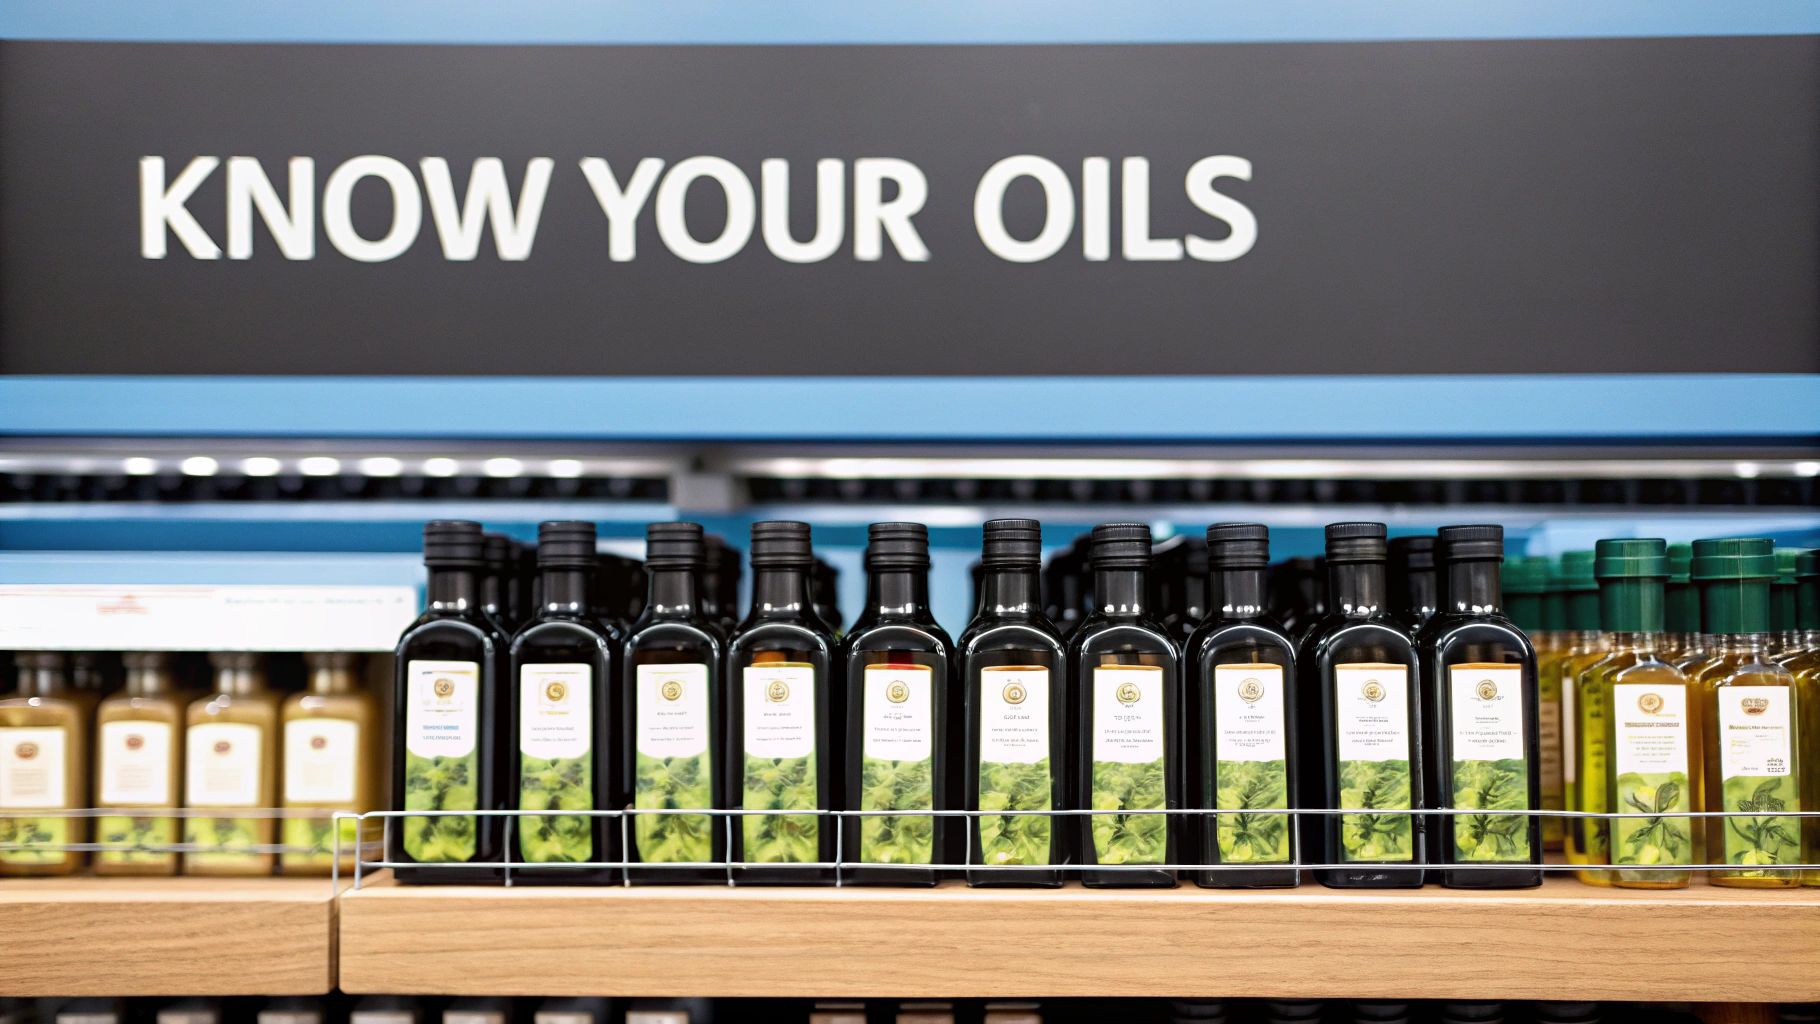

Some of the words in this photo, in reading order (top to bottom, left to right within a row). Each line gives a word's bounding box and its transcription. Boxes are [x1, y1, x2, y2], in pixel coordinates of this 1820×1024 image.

[139, 154, 554, 262] KNOW
[579, 154, 929, 264] YOUR
[973, 153, 1258, 262] OILS
